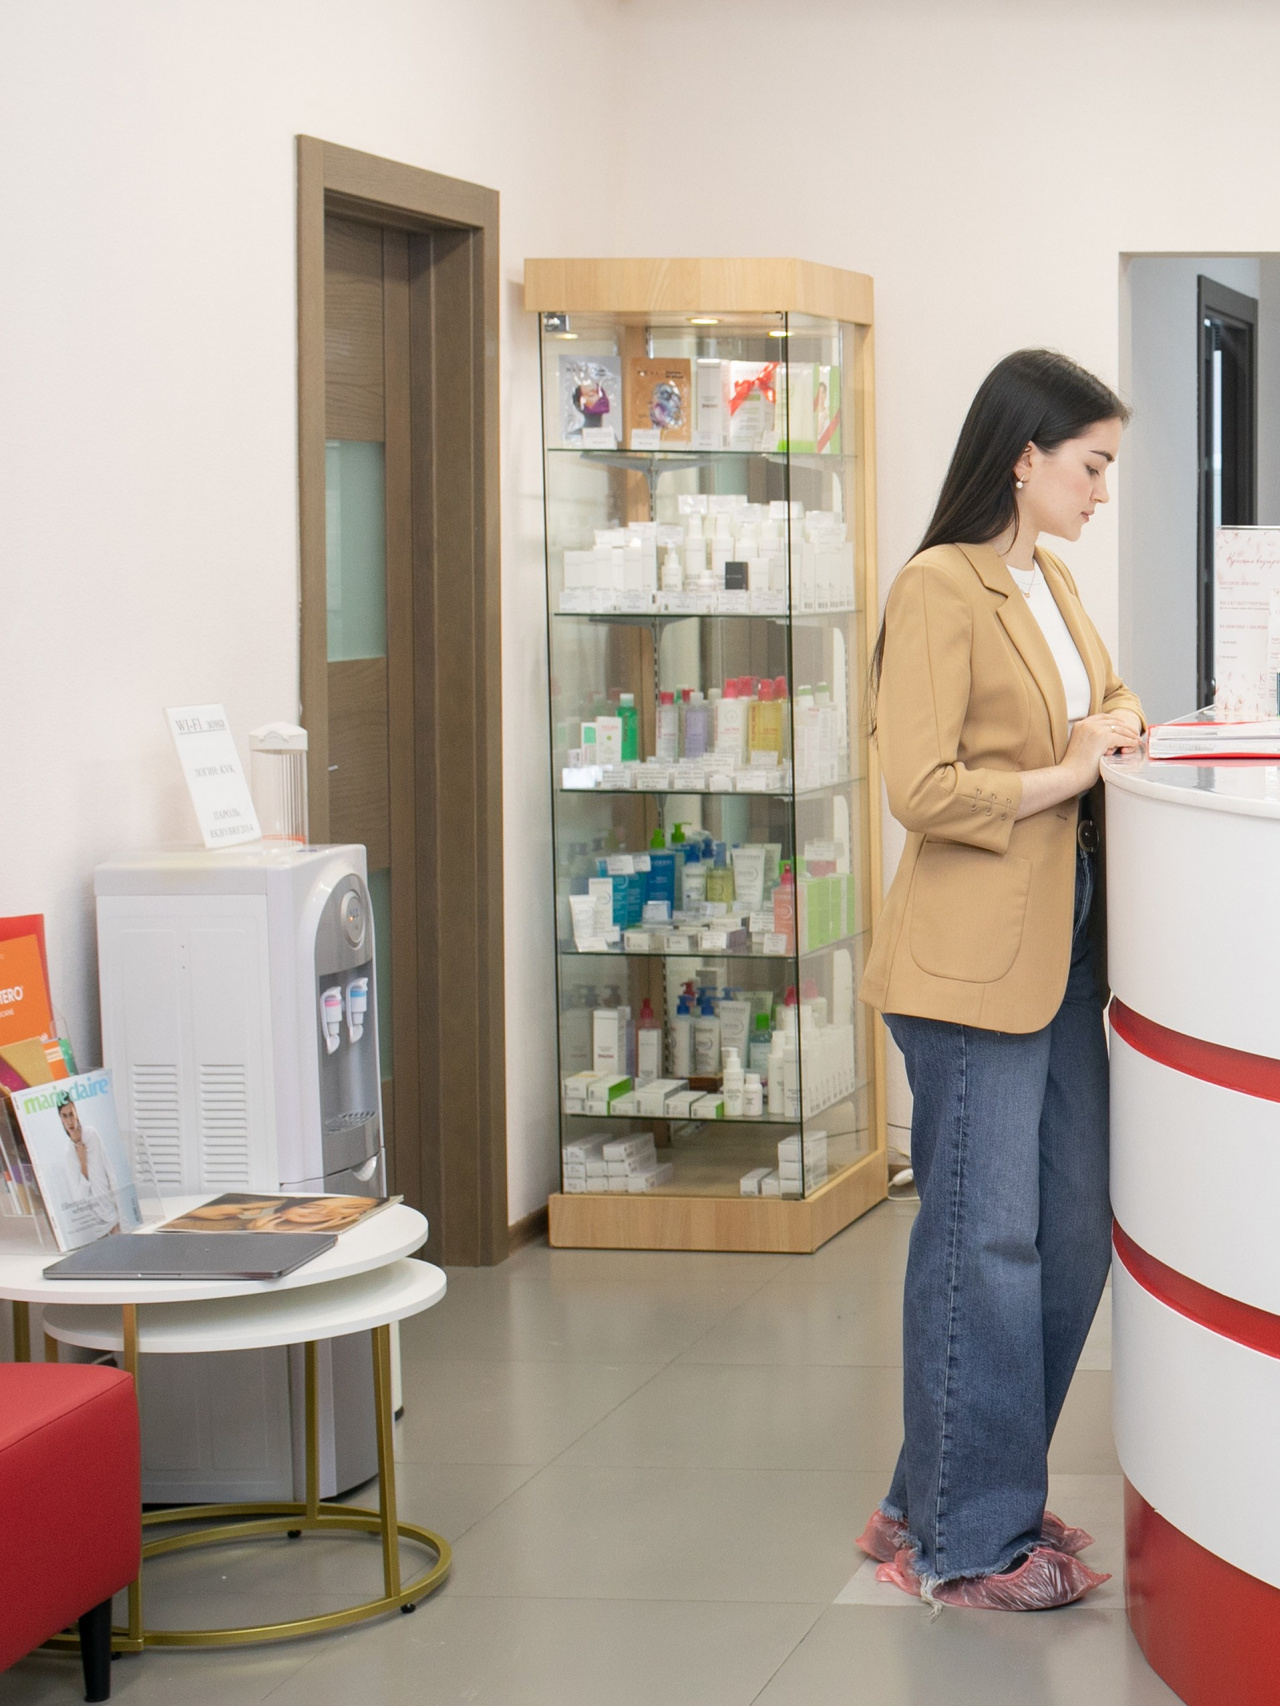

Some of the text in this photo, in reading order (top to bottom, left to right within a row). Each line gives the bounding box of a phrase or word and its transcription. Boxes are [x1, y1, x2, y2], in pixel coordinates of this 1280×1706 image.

[175, 718, 226, 732] WI-FI зона
[22, 1076, 109, 1115] marie claire
